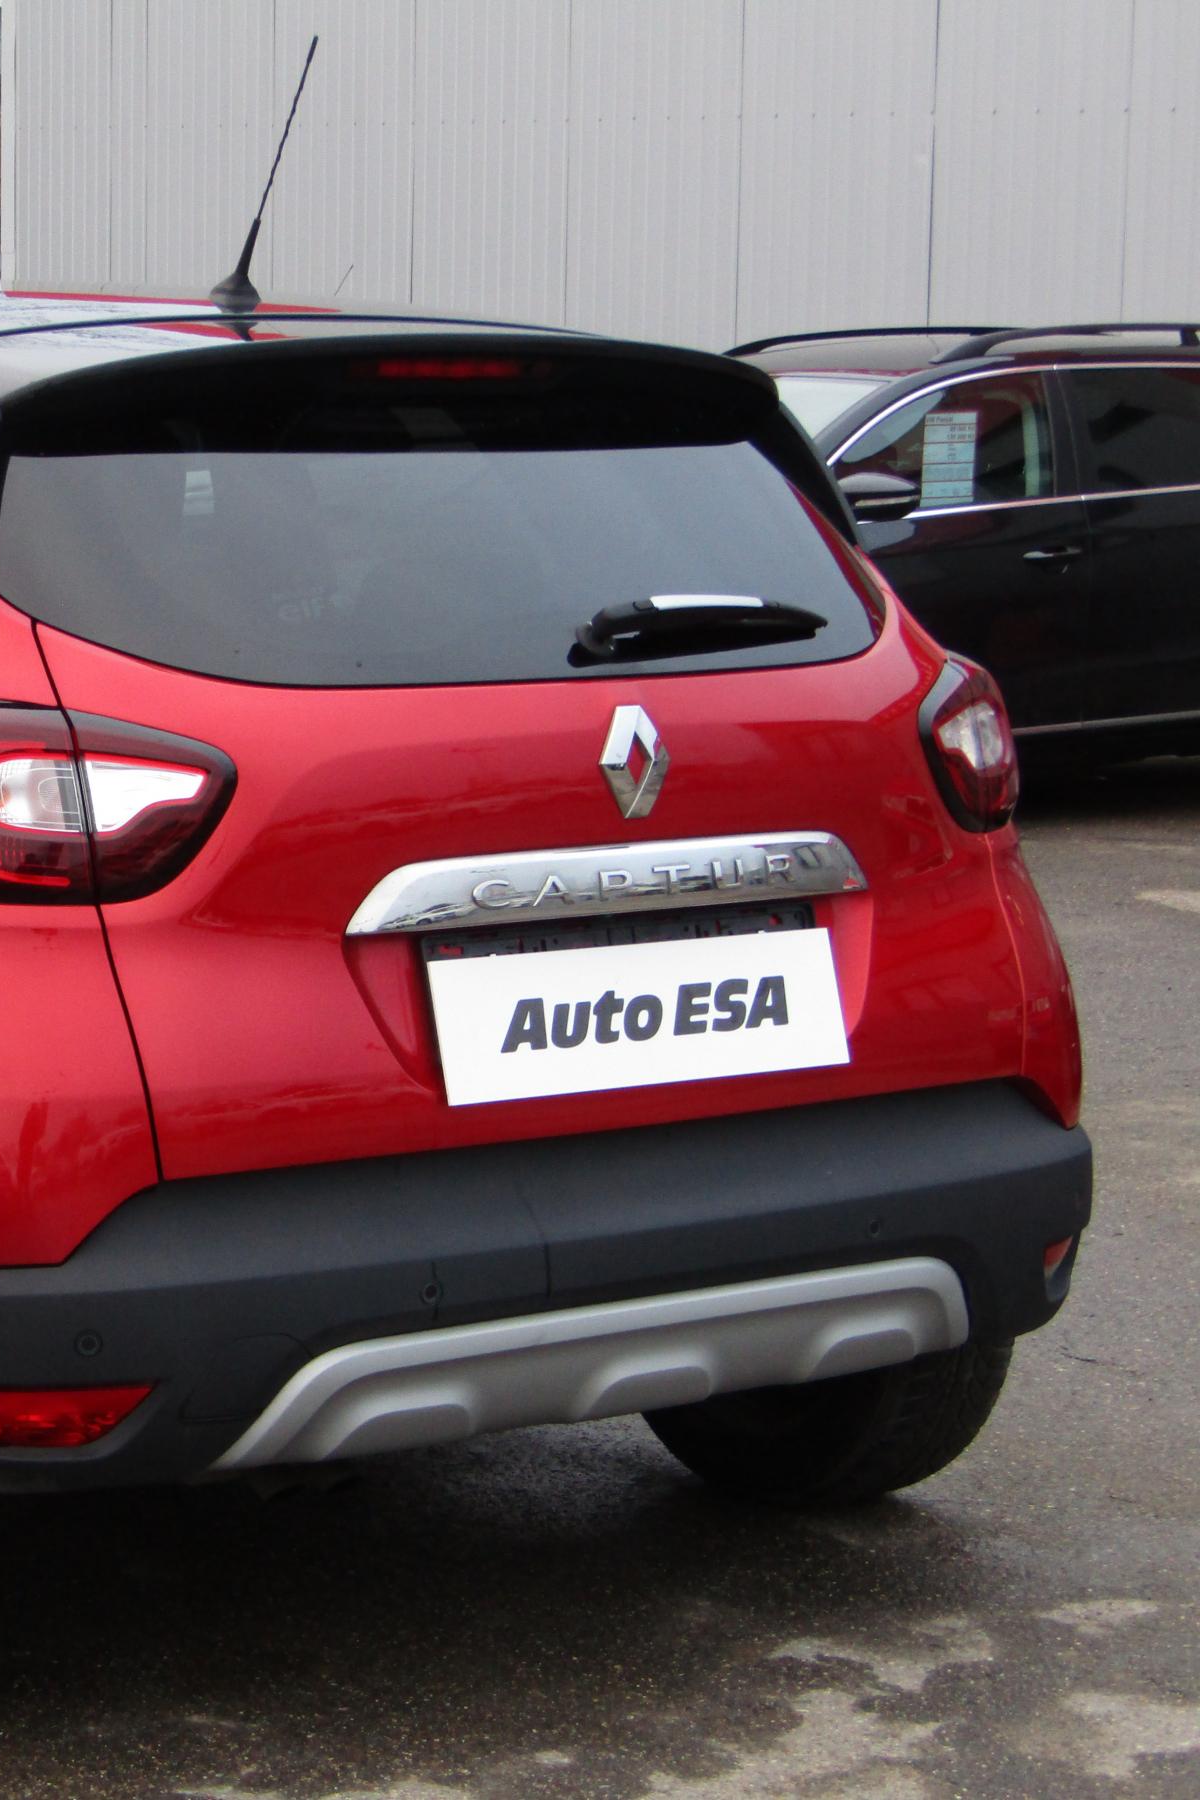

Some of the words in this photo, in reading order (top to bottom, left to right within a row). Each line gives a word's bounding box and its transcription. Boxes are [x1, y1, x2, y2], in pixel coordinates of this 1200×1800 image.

[471, 854, 796, 910] CAPTUR
[500, 990, 663, 1054] Auto
[673, 976, 789, 1036] ESA
